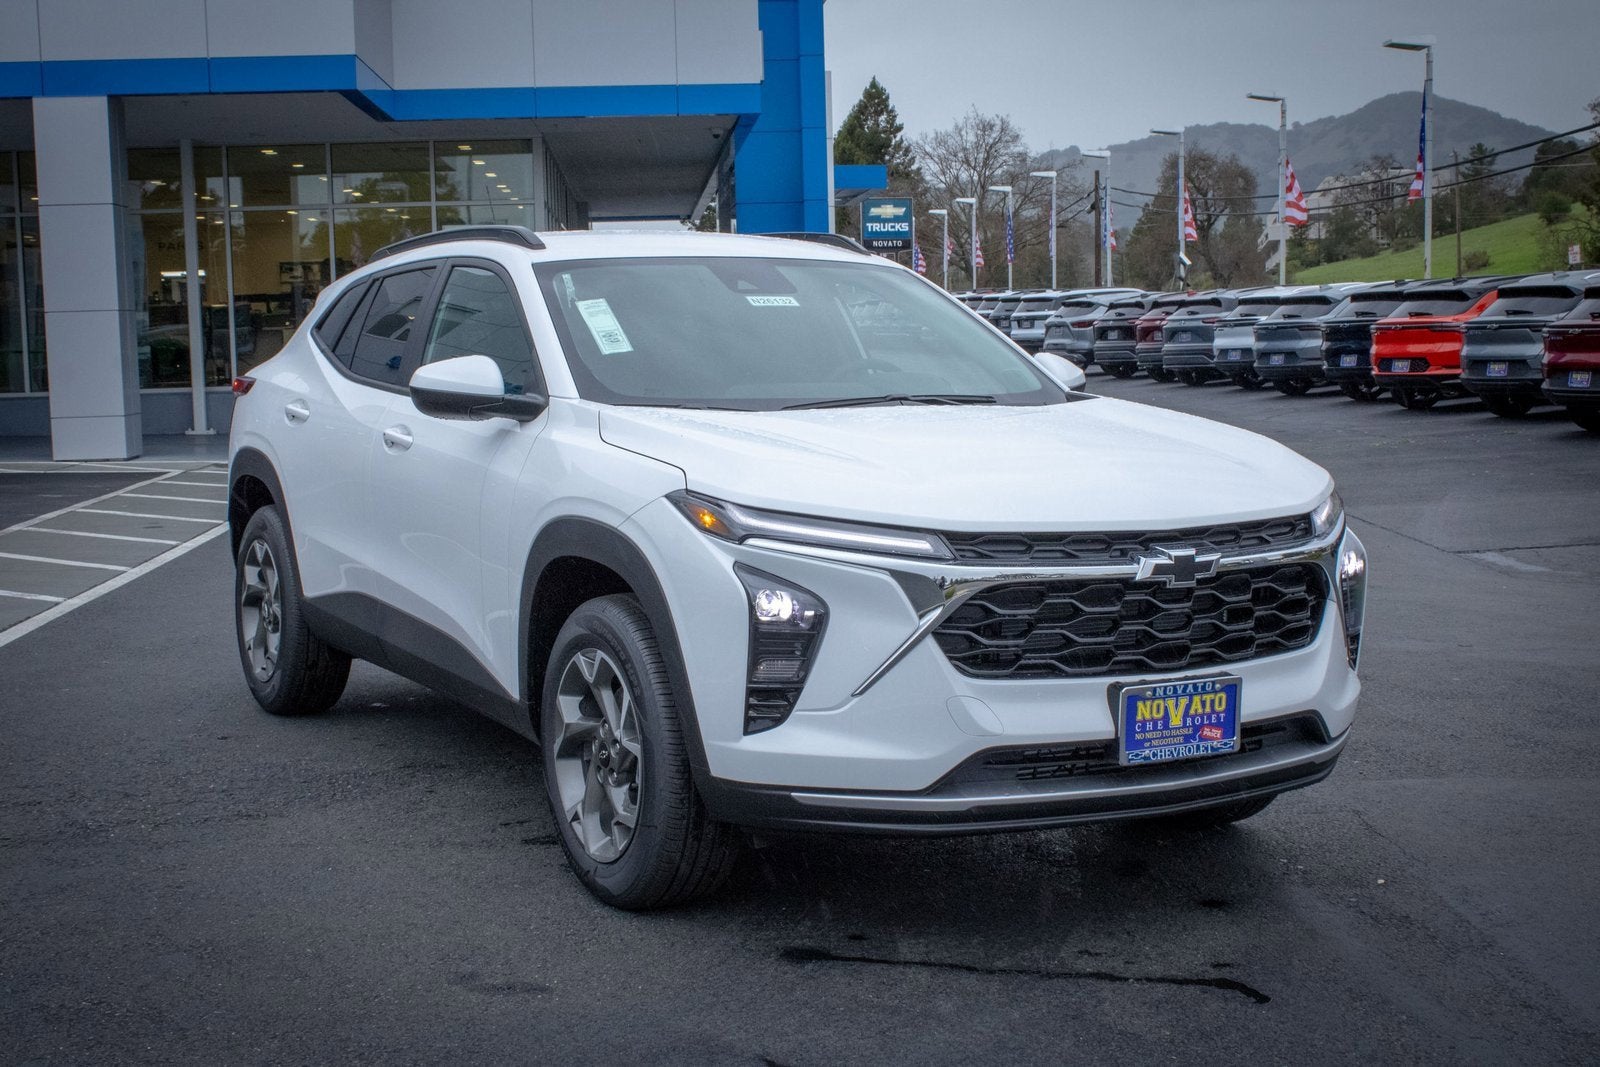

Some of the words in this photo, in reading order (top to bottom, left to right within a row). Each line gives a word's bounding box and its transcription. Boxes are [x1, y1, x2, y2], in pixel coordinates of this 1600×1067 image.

[866, 223, 909, 232] TRUCKS
[1155, 682, 1213, 697] NOVATO
[1136, 692, 1227, 728] NOVATO
[1135, 732, 1145, 741] NO
[1146, 730, 1162, 739] NEED
[1162, 729, 1171, 738] TO
[1171, 727, 1193, 737] HASSLE
[1151, 737, 1185, 747] NEGOTIATE
[1150, 743, 1213, 760] CHEVROLET
